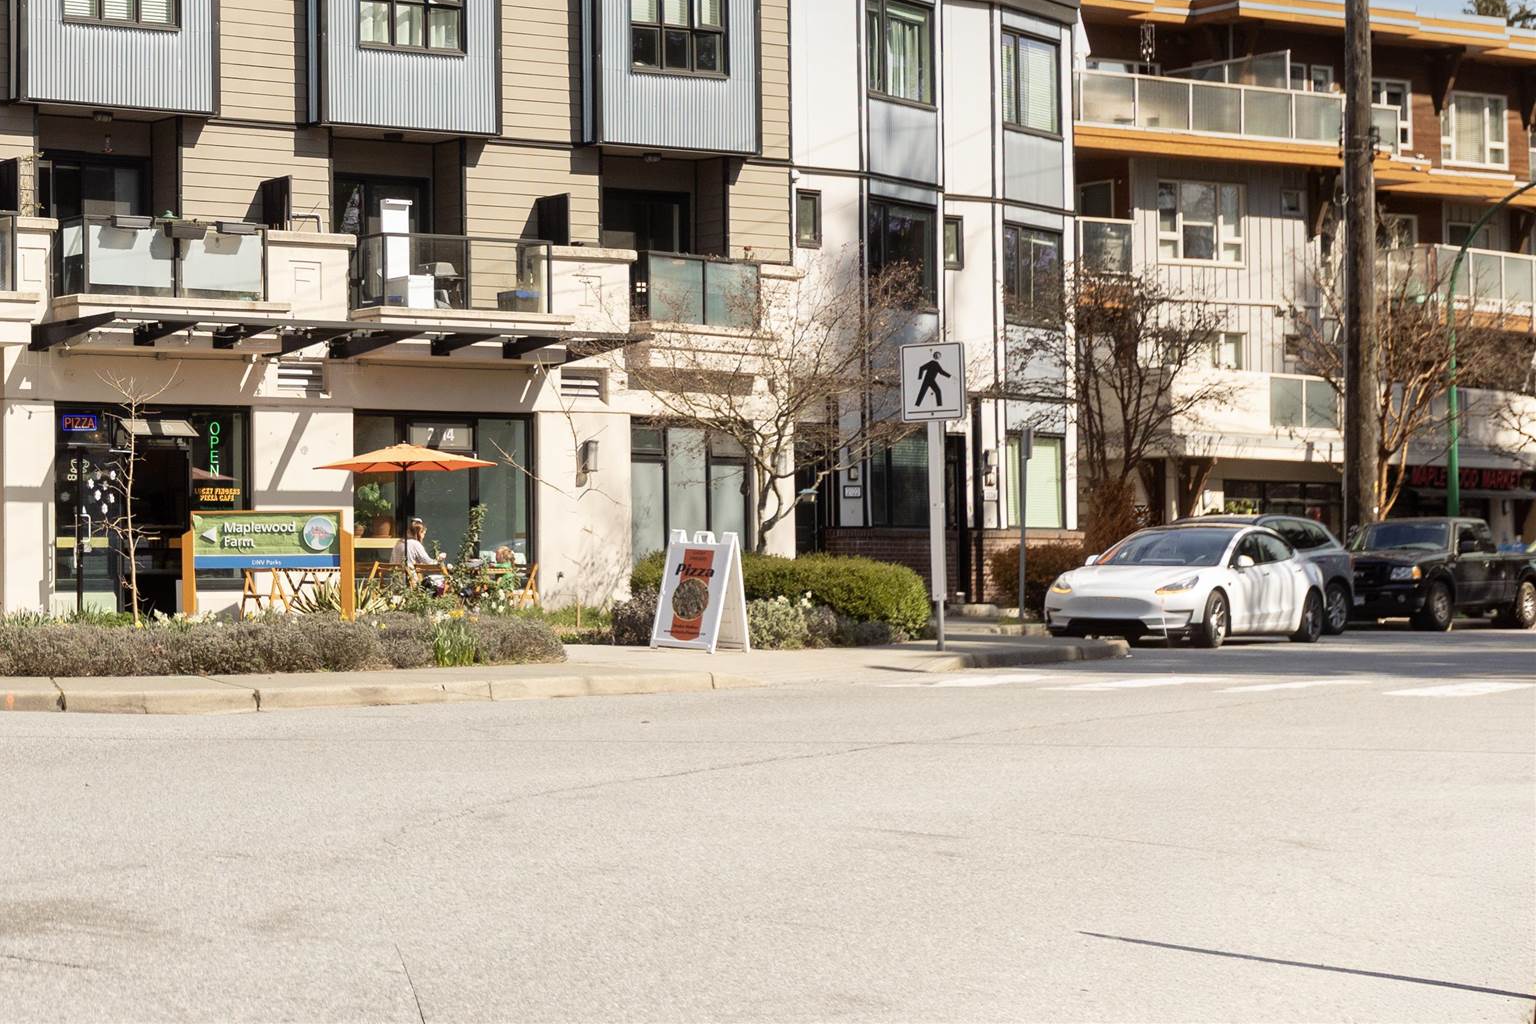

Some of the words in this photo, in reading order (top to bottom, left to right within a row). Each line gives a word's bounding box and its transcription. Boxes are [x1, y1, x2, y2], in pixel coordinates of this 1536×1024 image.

[64, 417, 95, 429] PIZZA
[209, 421, 221, 478] OPEN
[1412, 466, 1478, 488] MAPLEOOD
[224, 522, 295, 534] Maplewood
[224, 537, 255, 547] Farm
[675, 562, 715, 578] Pizza
